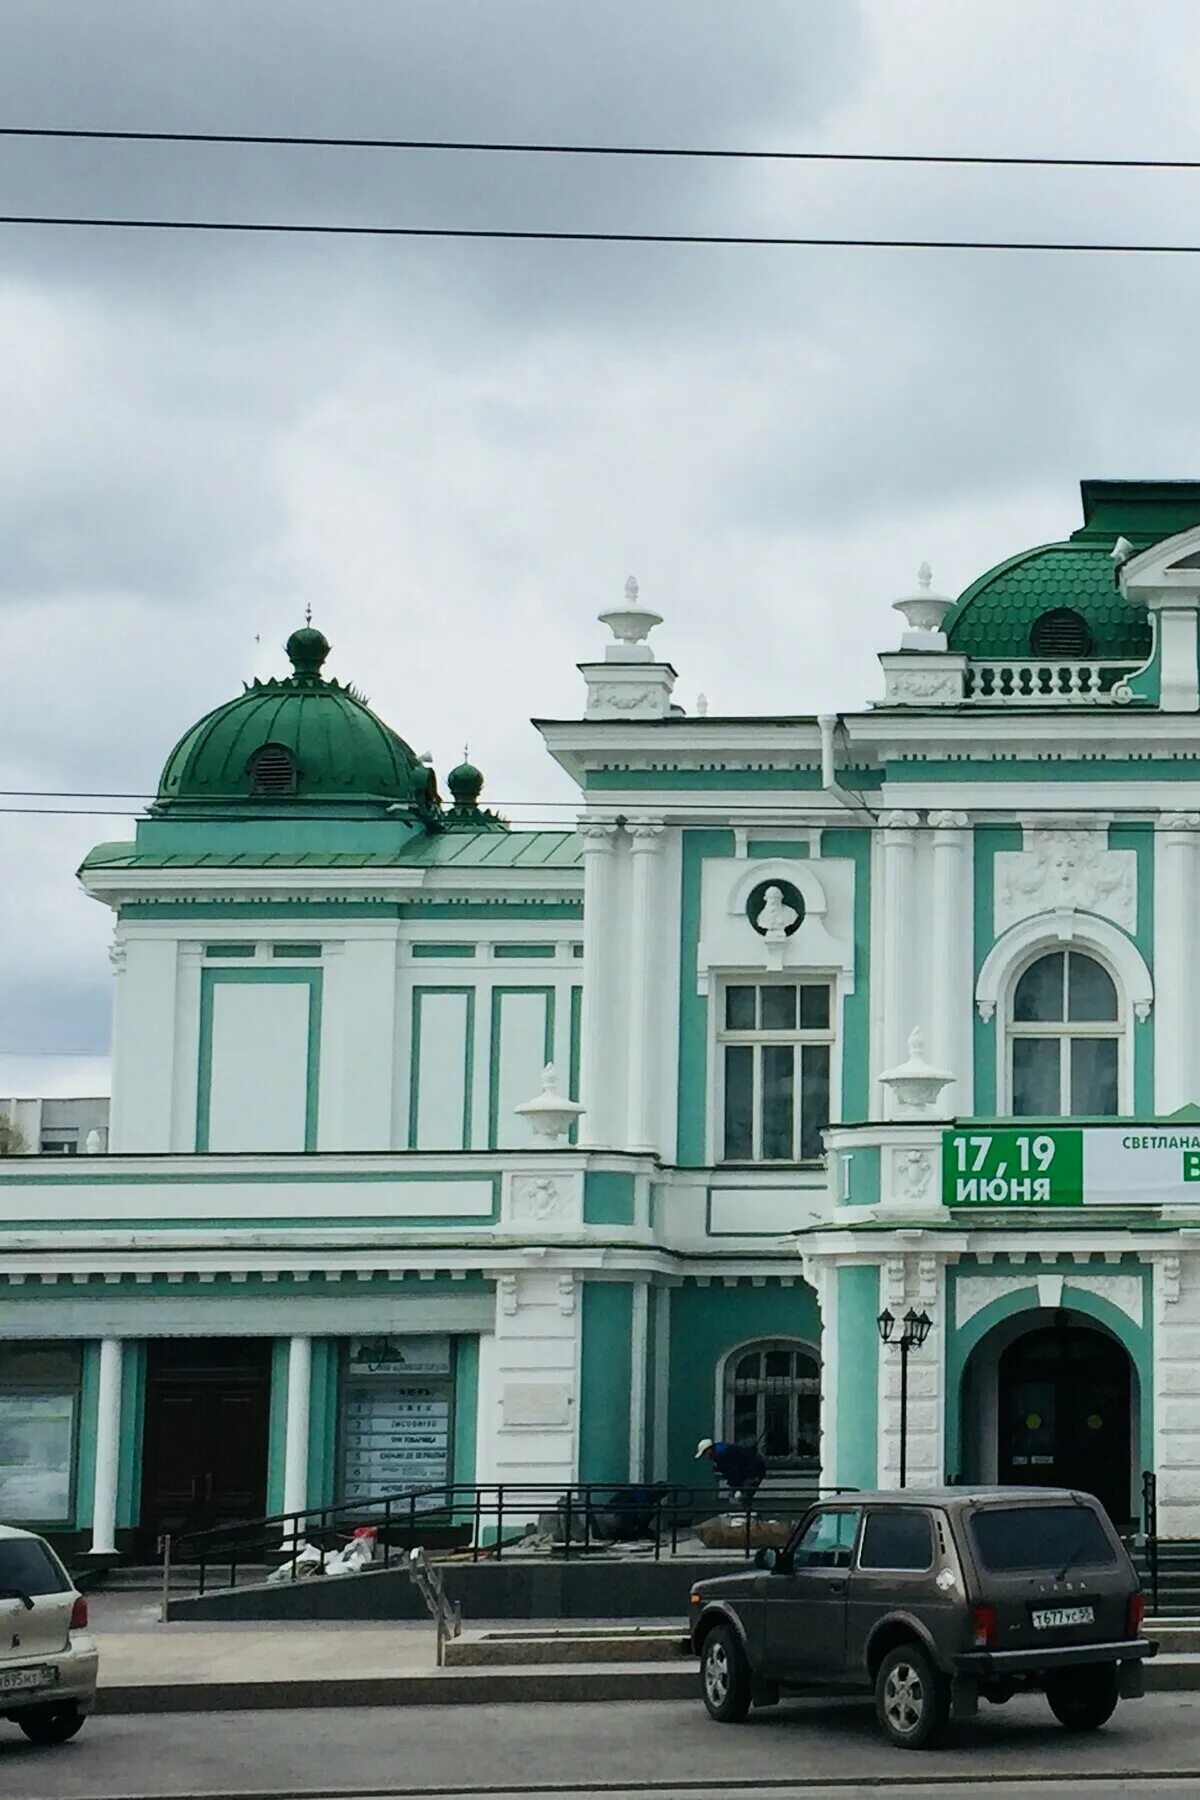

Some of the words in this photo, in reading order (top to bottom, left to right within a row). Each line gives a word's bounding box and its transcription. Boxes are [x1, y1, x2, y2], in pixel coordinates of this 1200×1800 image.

[1015, 1135, 1055, 1171] 19
[1122, 1135, 1200, 1150] СВЕТЛАНА
[956, 1177, 1050, 1202] ИЮНЯ
